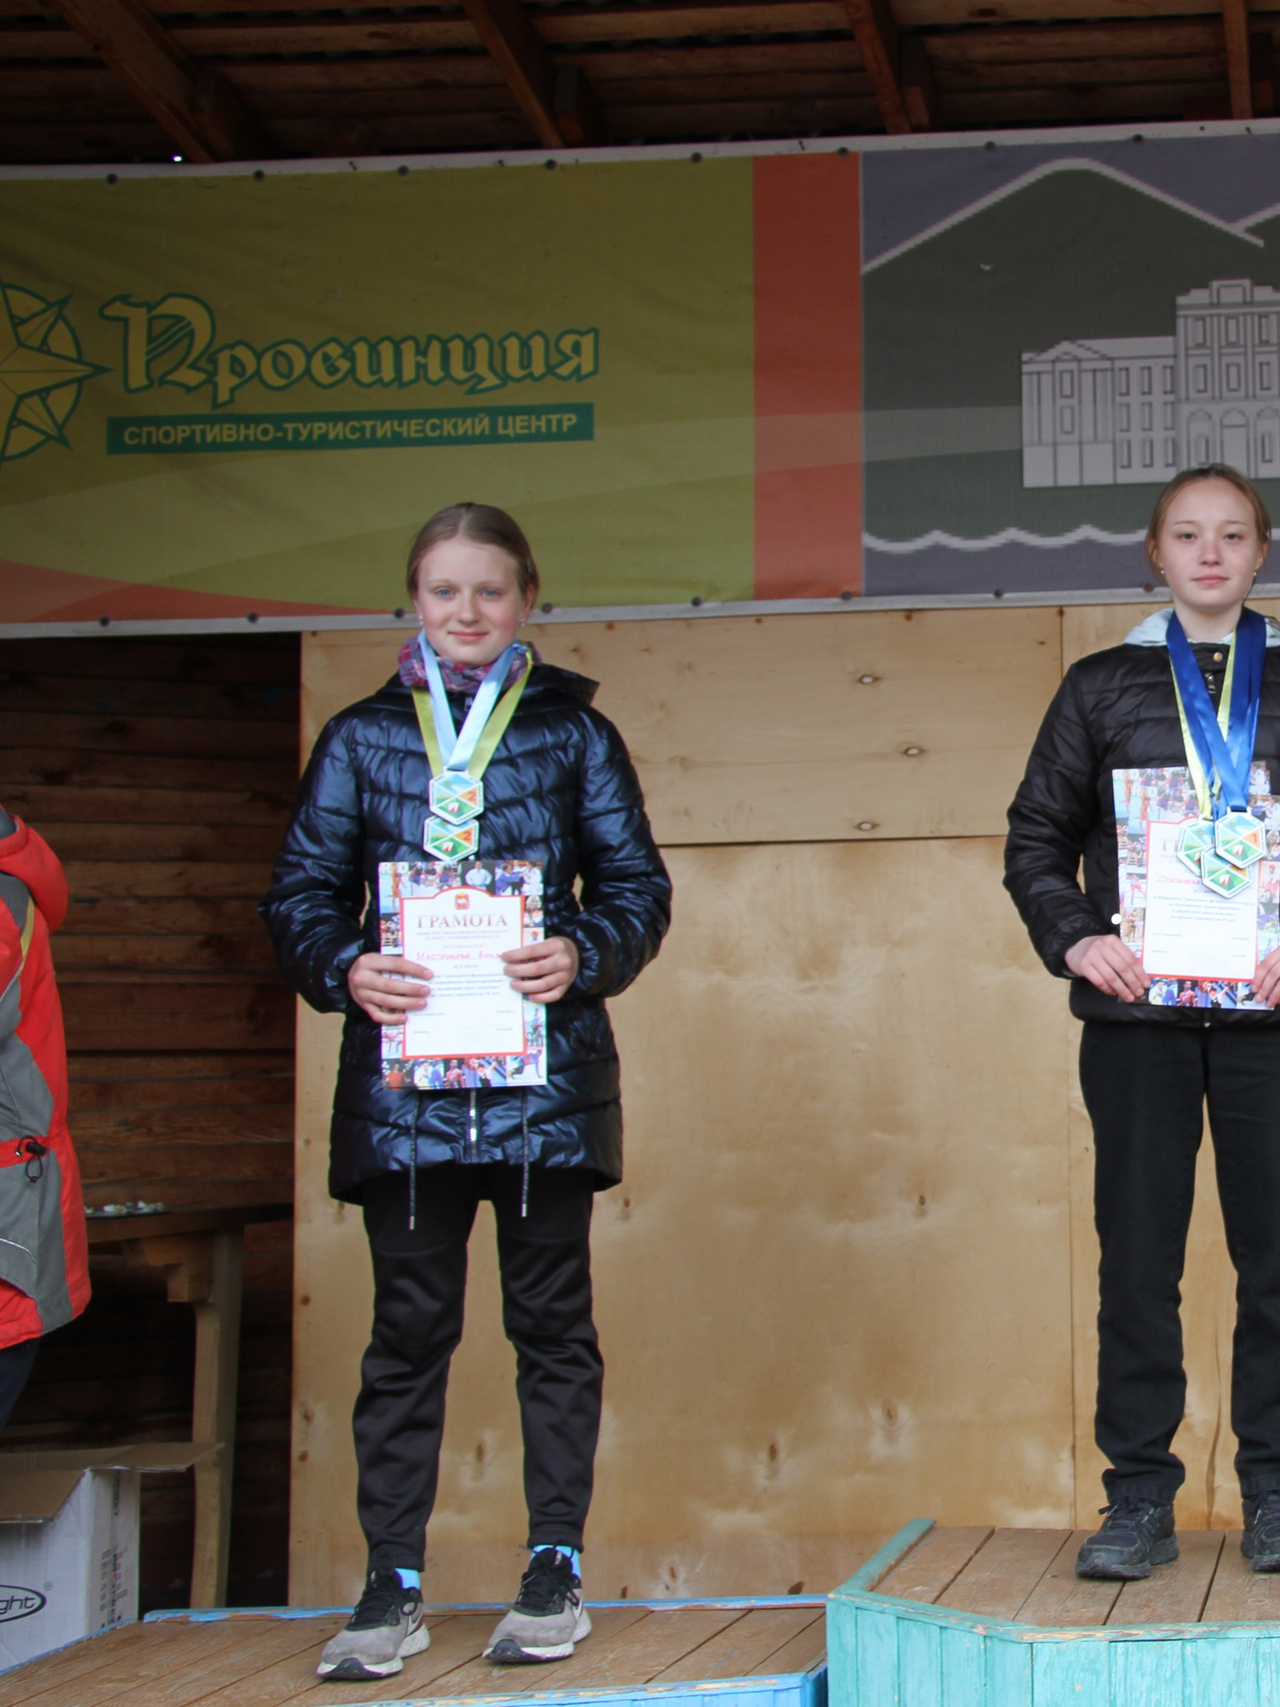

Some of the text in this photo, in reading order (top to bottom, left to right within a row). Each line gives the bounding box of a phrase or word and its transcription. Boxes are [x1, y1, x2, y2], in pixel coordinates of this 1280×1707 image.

[100, 292, 600, 409] Провинция
[123, 413, 577, 445] СПОРТИВНО-ТУРИСТИЧЕСКИЙ ЦЕНТР
[467, 791, 476, 801] 2
[462, 831, 472, 841] 2
[416, 912, 508, 929] ГРАМОТА
